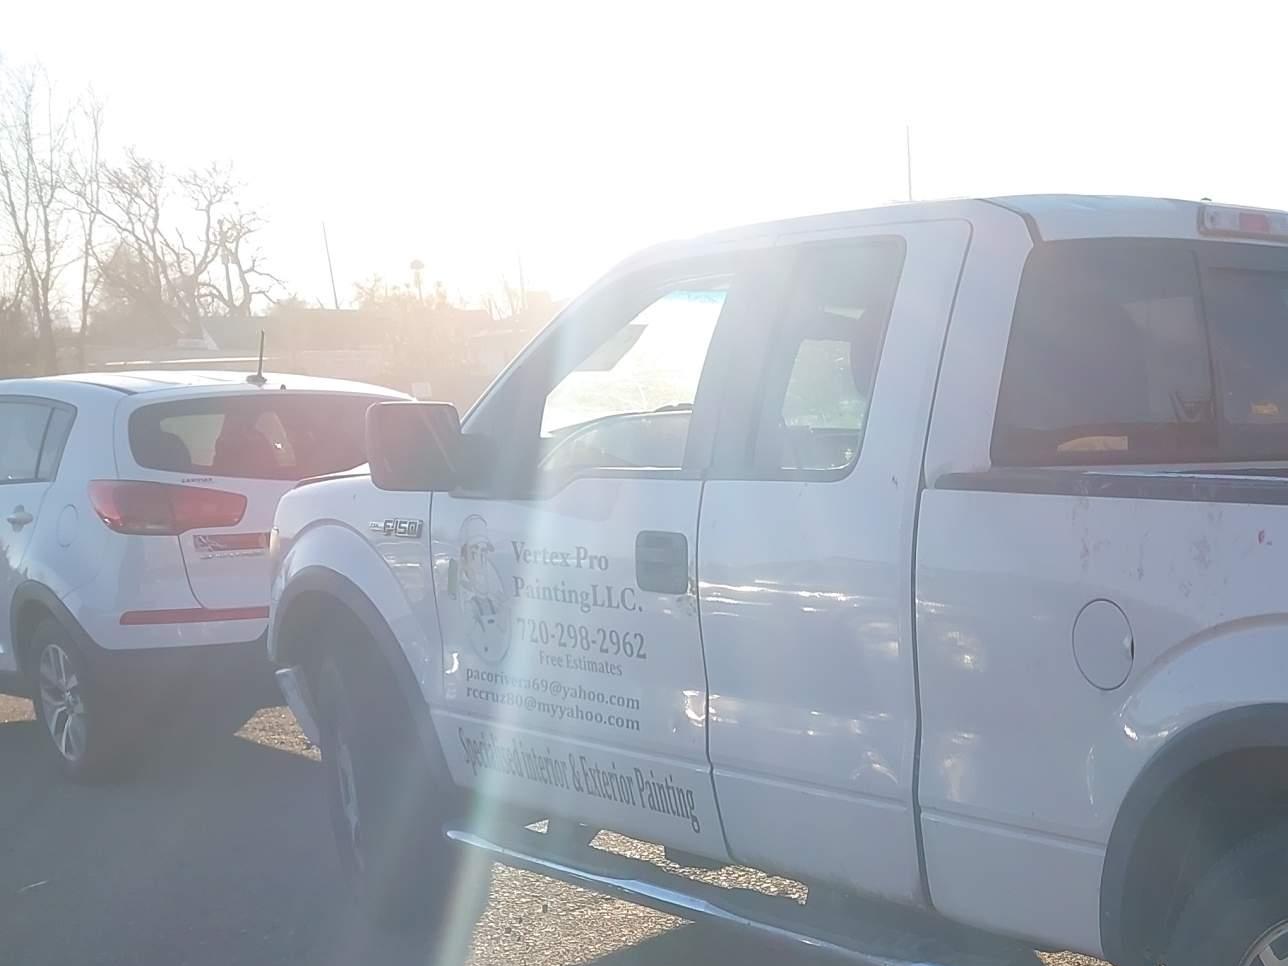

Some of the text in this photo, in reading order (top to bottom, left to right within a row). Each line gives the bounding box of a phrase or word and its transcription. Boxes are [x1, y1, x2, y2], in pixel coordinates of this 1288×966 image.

[511, 540, 609, 571] Vertex Pro
[515, 617, 648, 660] 720-298-2962
[539, 650, 624, 677] Free Estimates
[466, 667, 641, 711] pacorivera69@yahoo.com
[466, 685, 641, 732] rccruz80@myyahoo.com
[521, 743, 571, 791] interior
[568, 752, 584, 793] &
[580, 755, 637, 808] Exterior
[634, 767, 701, 834] Painting
